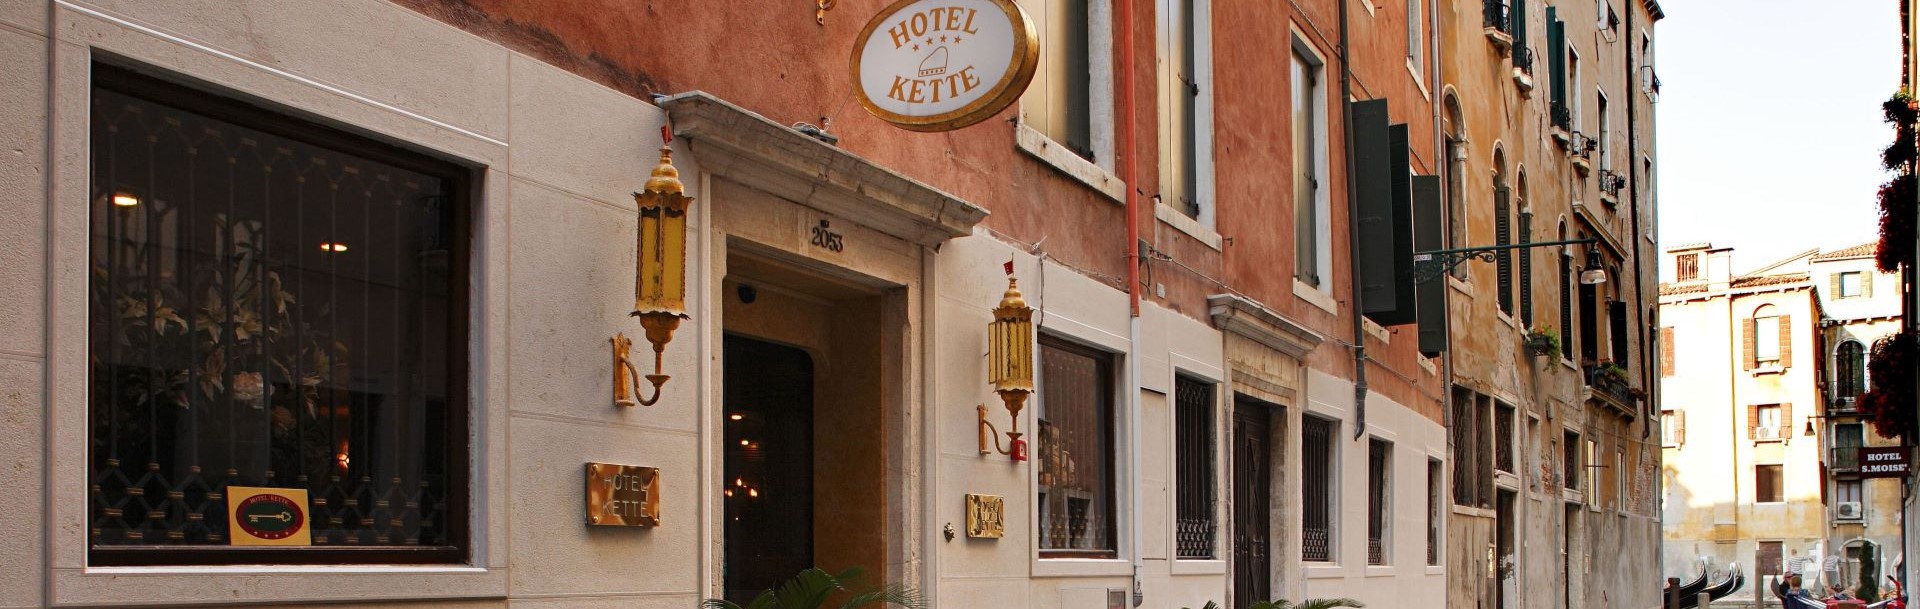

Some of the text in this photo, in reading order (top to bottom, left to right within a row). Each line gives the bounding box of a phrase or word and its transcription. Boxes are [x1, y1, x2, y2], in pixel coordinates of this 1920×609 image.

[888, 7, 979, 49] HOTEL
[887, 65, 980, 104] KETTE
[812, 227, 843, 252] 2053
[1867, 453, 1901, 461] HOTEL
[603, 475, 649, 492] HOTEL
[602, 500, 649, 518] KETTE
